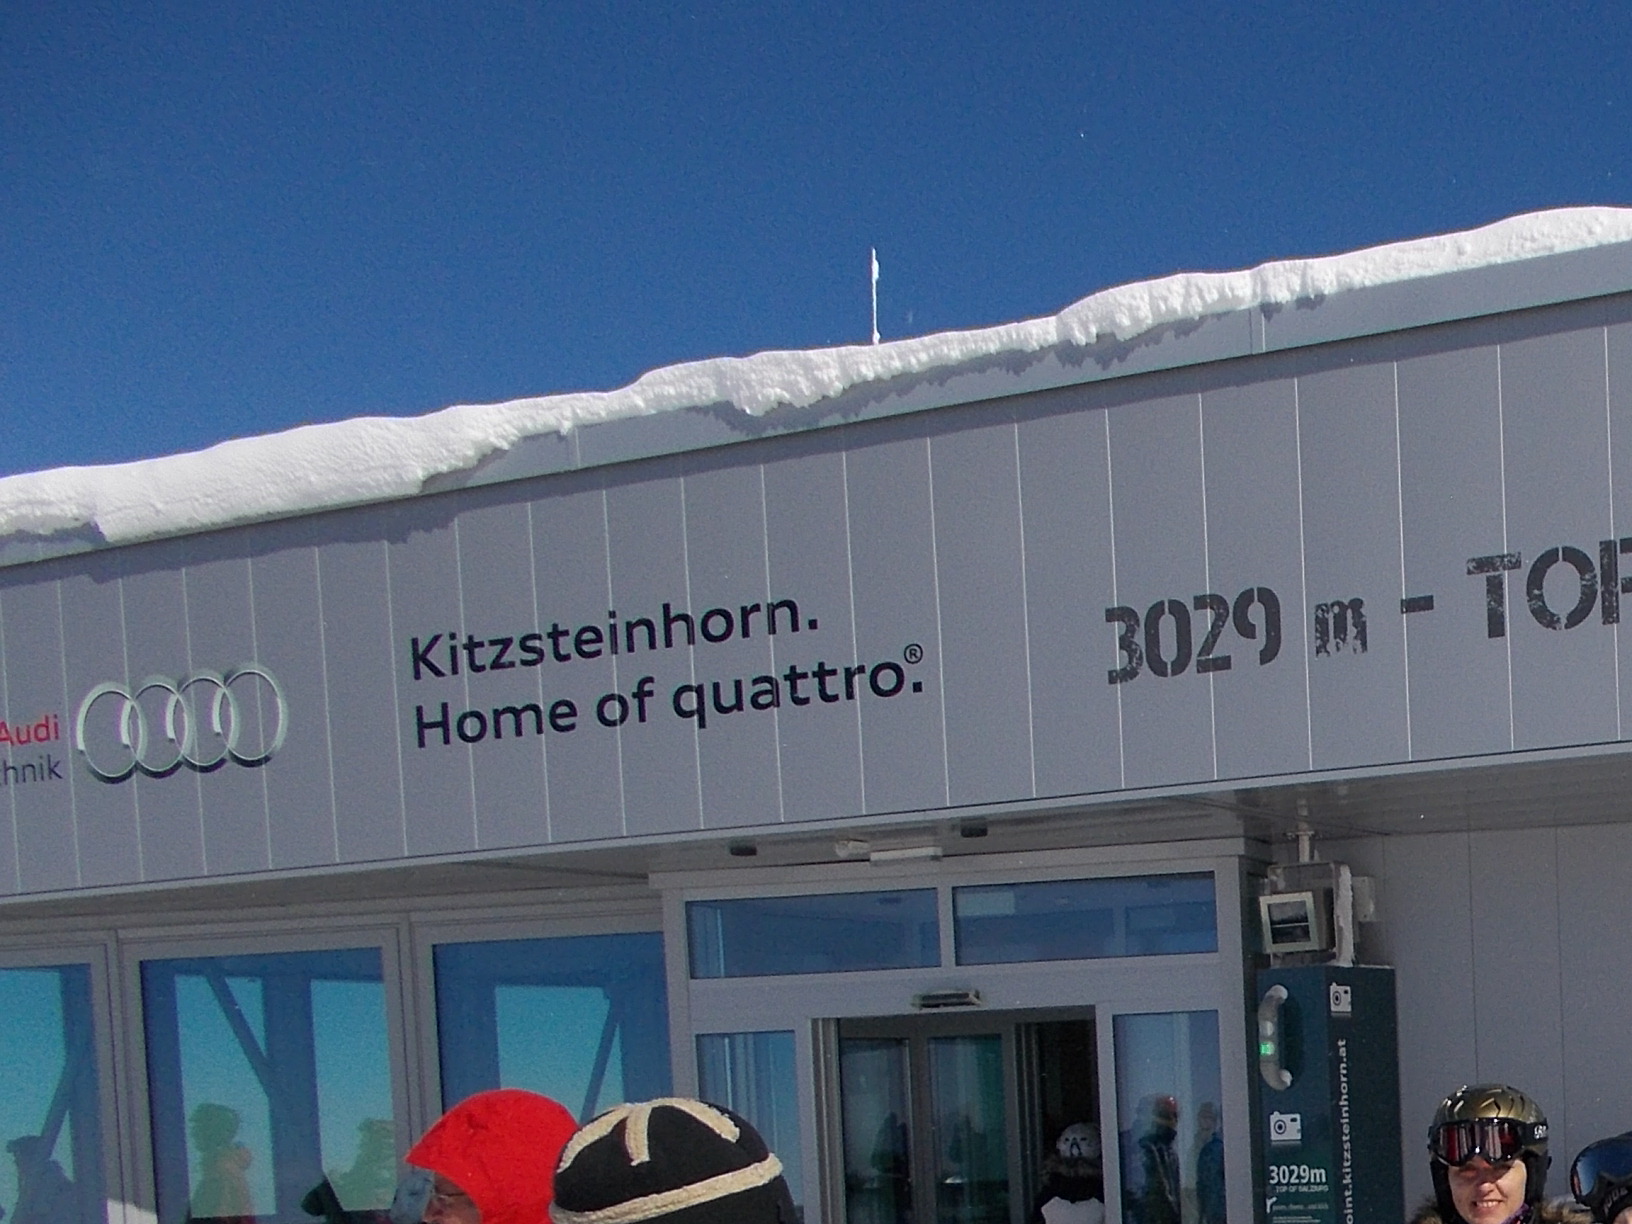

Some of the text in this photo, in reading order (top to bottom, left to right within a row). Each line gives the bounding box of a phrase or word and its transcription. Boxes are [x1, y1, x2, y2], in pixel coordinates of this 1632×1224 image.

[411, 598, 818, 681] Kitzsteinhorn.
[1105, 586, 1282, 685] 3029
[1314, 597, 1368, 661] m
[416, 698, 578, 748] Home
[596, 675, 655, 728] of
[1268, 1164, 1327, 1184] 3029m
